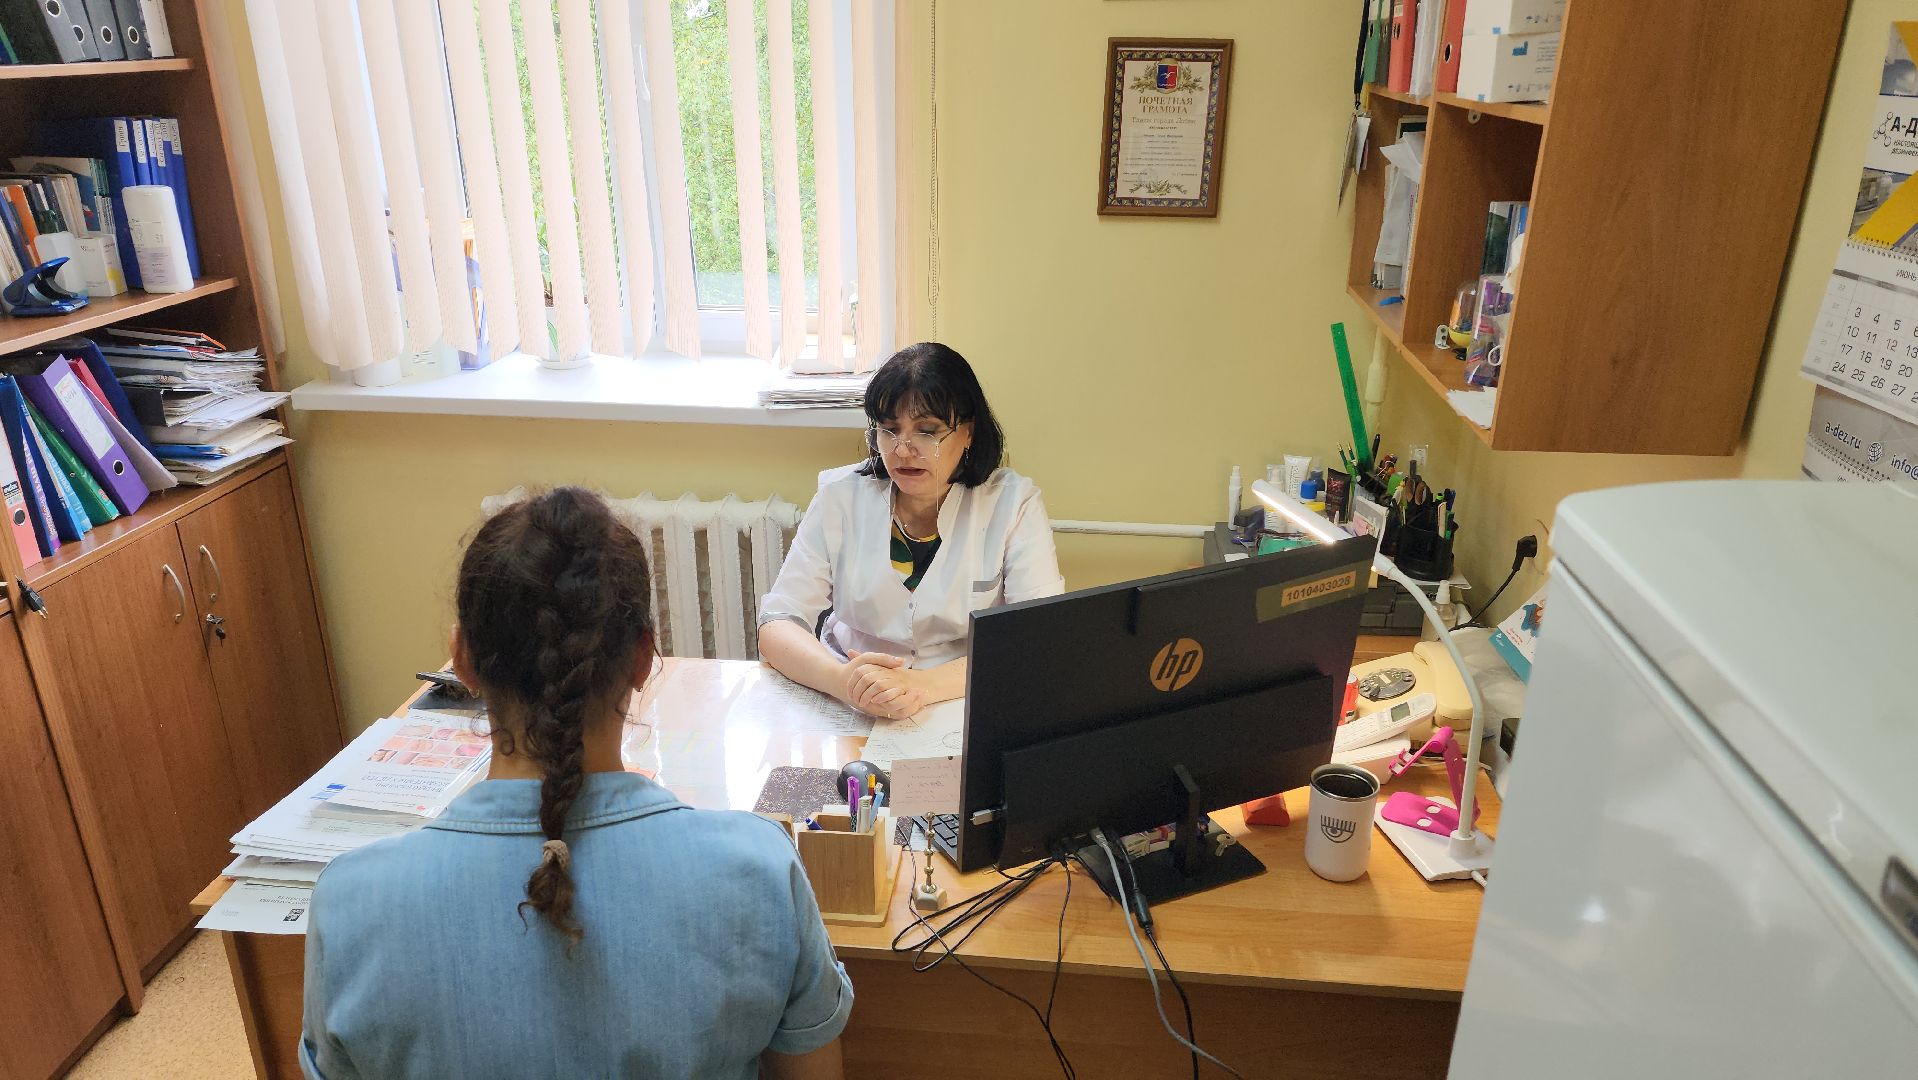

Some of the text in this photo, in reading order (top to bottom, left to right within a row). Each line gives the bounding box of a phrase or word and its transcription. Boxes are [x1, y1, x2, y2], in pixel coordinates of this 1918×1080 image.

[1138, 96, 1193, 105] ПОЧЕТНАЯ
[1143, 105, 1188, 114] ГРАМОТА
[1854, 307, 1862, 318] 3
[1873, 313, 1881, 325] 4
[1893, 319, 1901, 331] 5
[1847, 325, 1918, 359] 10 11 12 13
[1841, 343, 1913, 378] 17 18 19 20
[1832, 361, 1847, 374] 24
[1850, 368, 1866, 382] 25
[1870, 375, 1886, 389] 26
[1890, 383, 1906, 397] 27
[1825, 422, 1862, 450] a-dez.ru
[1156, 639, 1199, 691] hp
